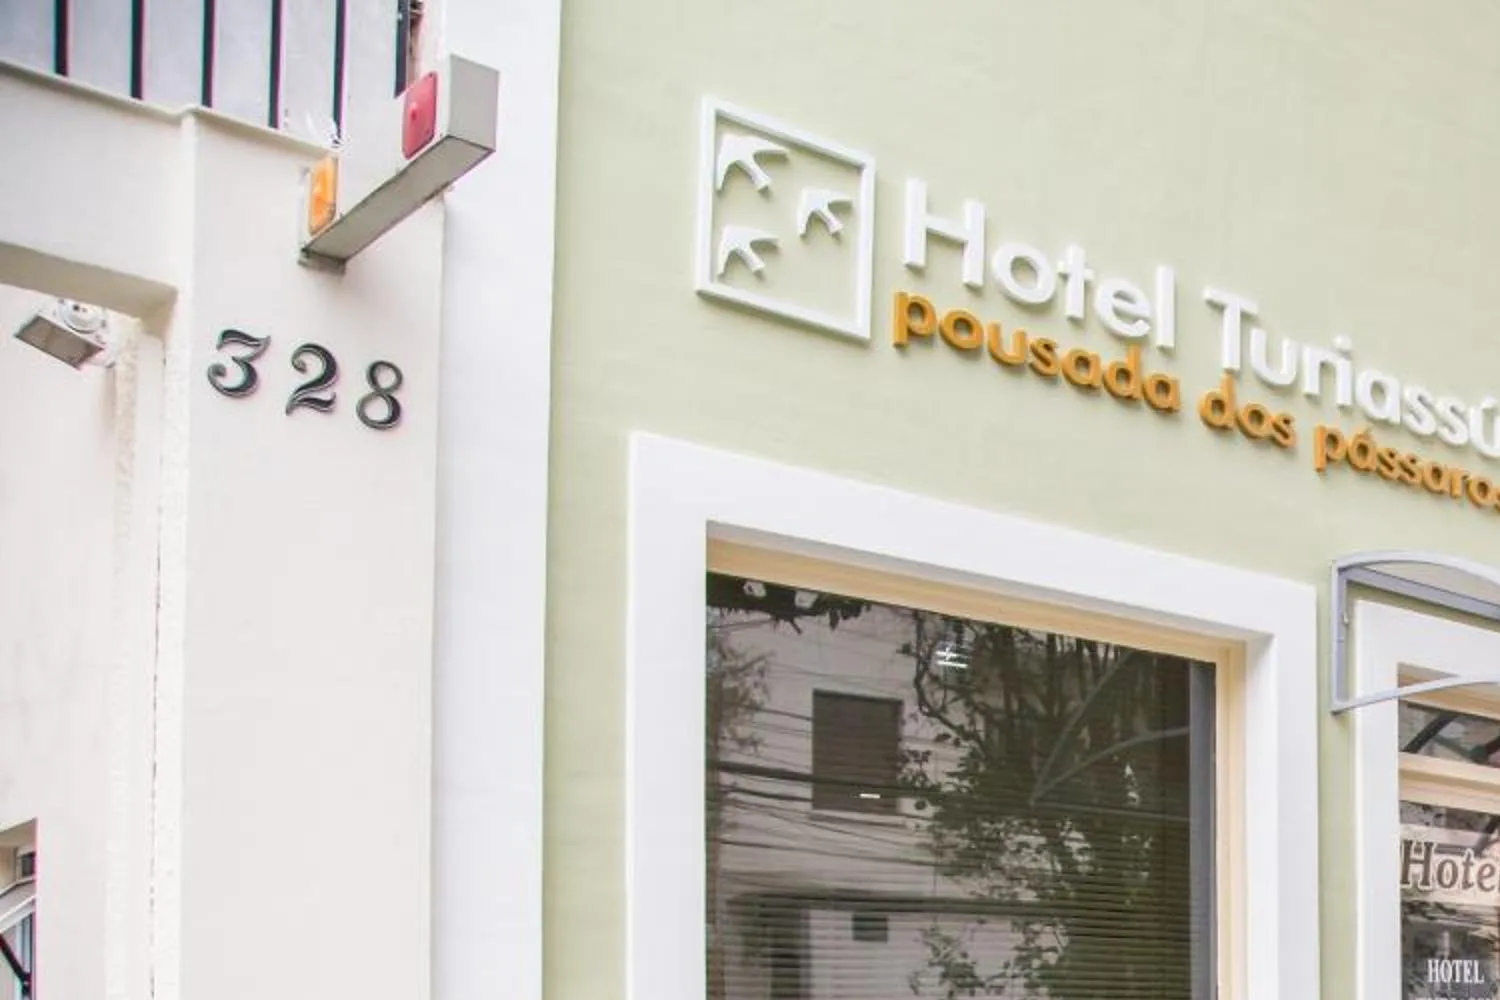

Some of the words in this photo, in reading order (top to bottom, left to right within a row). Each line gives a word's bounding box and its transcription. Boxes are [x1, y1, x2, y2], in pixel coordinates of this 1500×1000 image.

[903, 177, 1176, 350] Hotel
[207, 328, 404, 430] 328
[893, 291, 1182, 413] pousada
[1197, 371, 1298, 449] dos
[1426, 958, 1485, 984] HOTEL
